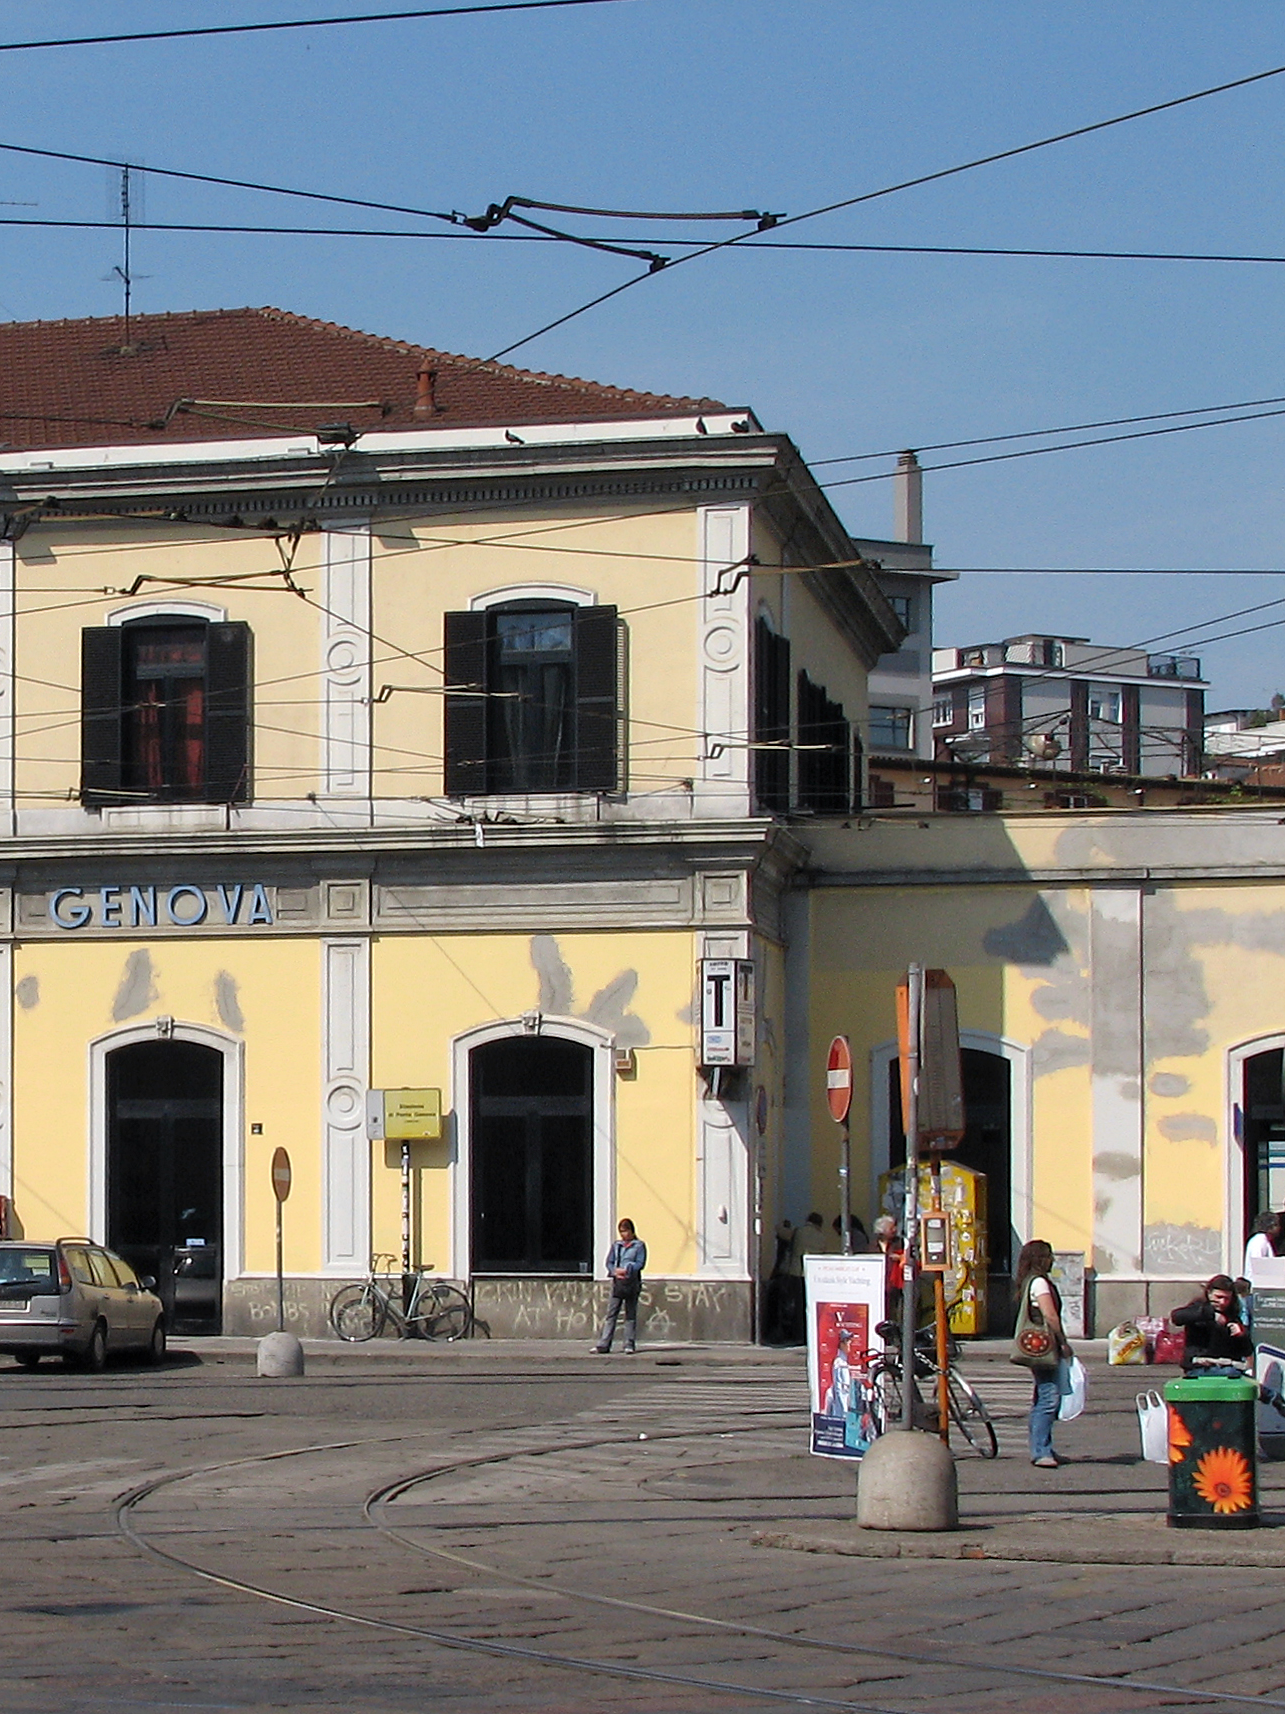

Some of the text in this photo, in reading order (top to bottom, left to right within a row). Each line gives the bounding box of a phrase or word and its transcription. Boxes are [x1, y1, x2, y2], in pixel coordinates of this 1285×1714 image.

[49, 883, 273, 928] GENOVA
[707, 974, 731, 1027] T
[665, 1283, 725, 1312] STAY
[514, 1304, 542, 1329] AT
